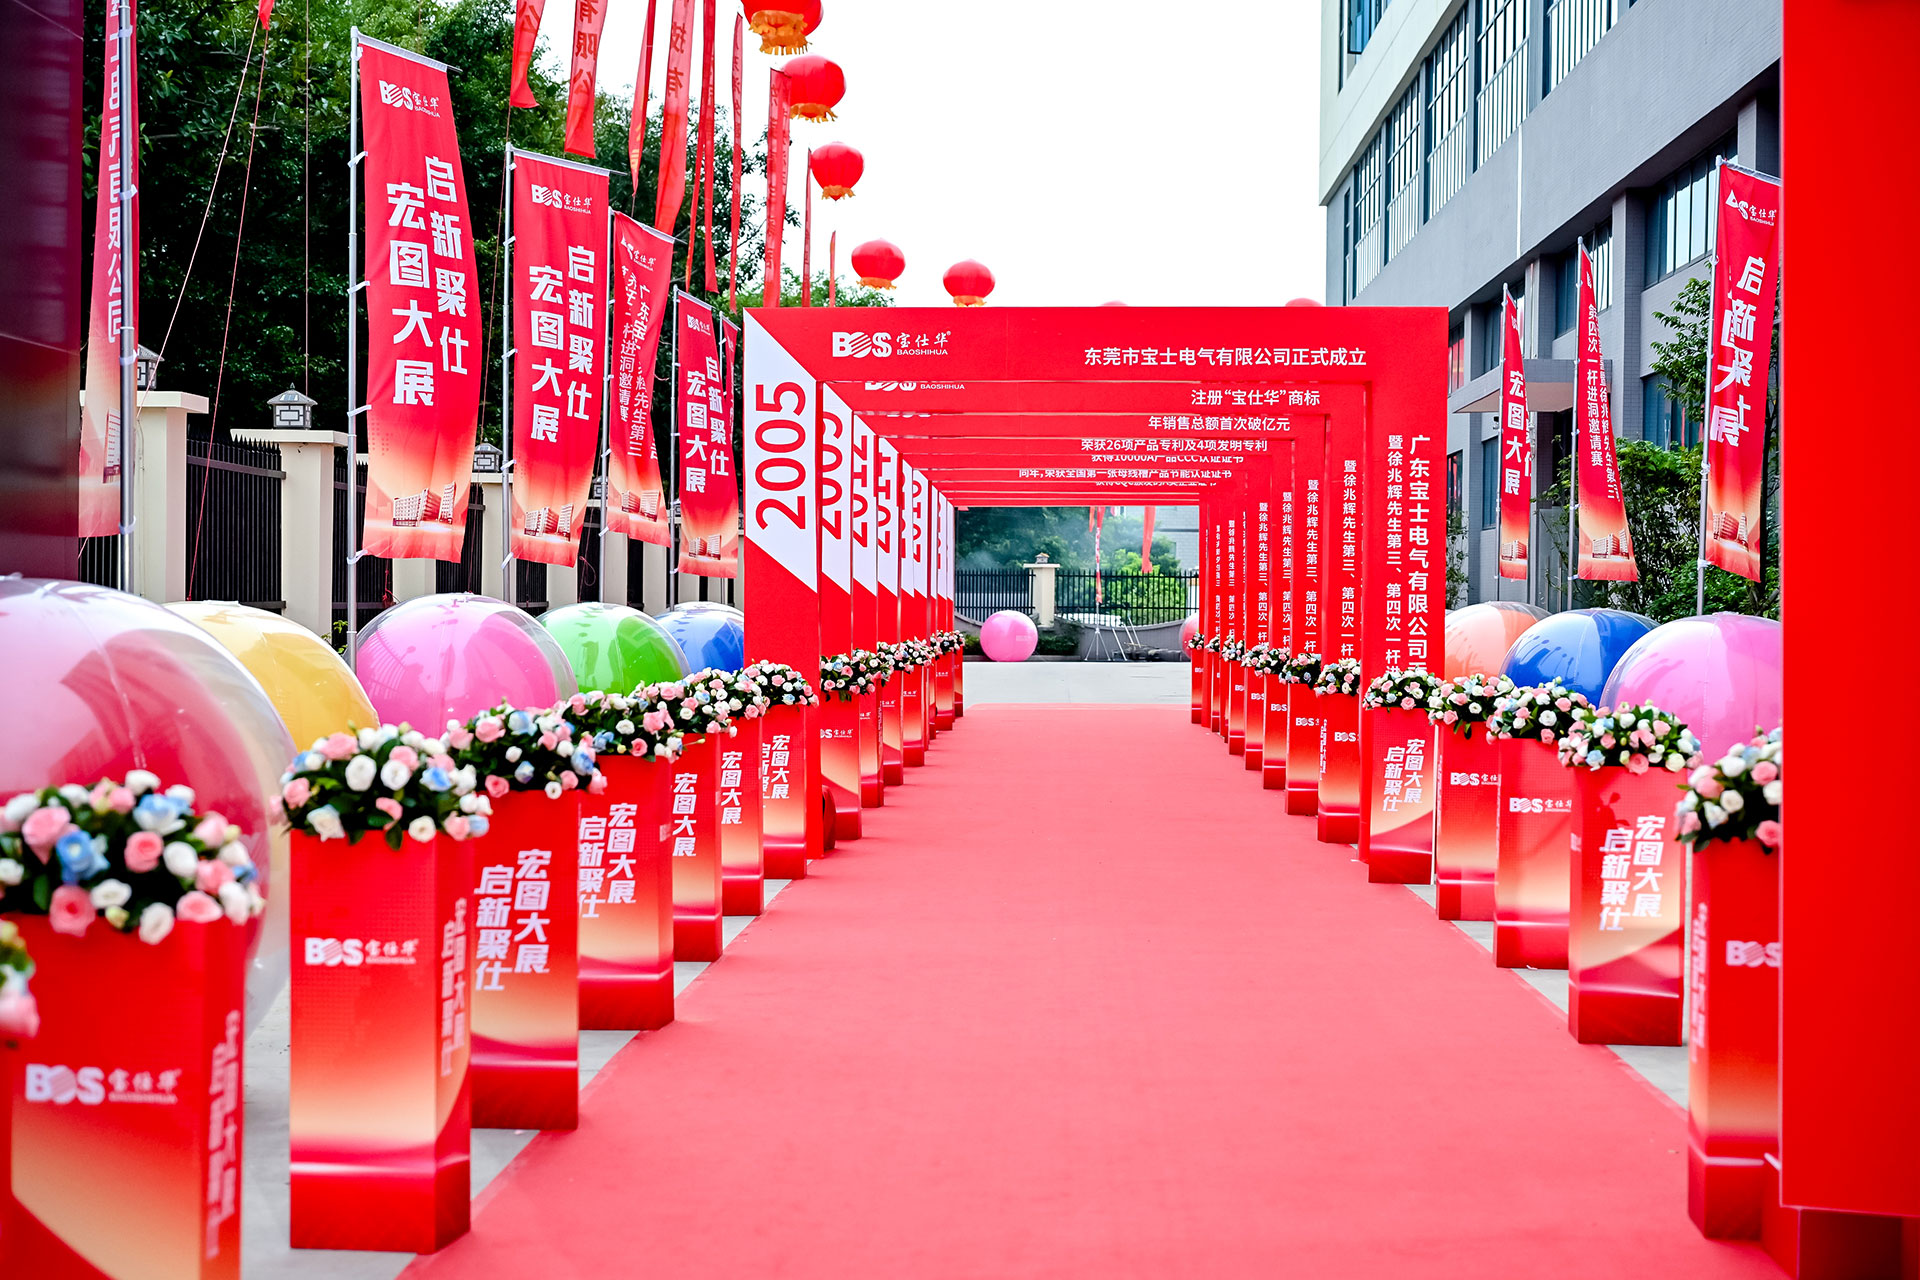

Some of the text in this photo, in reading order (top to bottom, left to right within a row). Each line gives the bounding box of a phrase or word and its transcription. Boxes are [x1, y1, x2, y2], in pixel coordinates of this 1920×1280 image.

[378, 79, 414, 111] BOS
[531, 183, 593, 210] BOS 宝仕华
[386, 181, 435, 407] 宏图大展
[425, 155, 469, 376] 启新聚仕
[528, 264, 564, 443] 宏图大展
[566, 245, 596, 421] 启新聚仕
[832, 331, 951, 359] BOS 宝仕华
[896, 348, 948, 356] BAOSHIHUA
[1084, 346, 1367, 367] 东莞市宝士电气有限公司正式成立
[685, 370, 708, 494] 宏图大展
[705, 355, 730, 477] 启新聚仕
[1081, 438, 1268, 452] 荣获26项产品专利及4项发明专利
[1148, 415, 1291, 432] 年销售总额首次破亿元
[1505, 370, 1525, 496] 宏图大展
[754, 381, 807, 530] 2005
[1257, 502, 1269, 645] 暨徐兆辉先生第三、第四次一杆
[1340, 459, 1358, 660] 暨徐兆辉先生第三、第四次一杆
[1270, 703, 1288, 712] BOS
[1295, 717, 1315, 727] BOS
[1334, 731, 1357, 742] BOS
[720, 750, 743, 825] 宏图大展
[770, 734, 791, 799] 宏图大展
[1382, 745, 1406, 813] 启新聚仕
[1403, 738, 1426, 804] 宏图大展
[1450, 772, 1480, 786] BOS
[672, 772, 698, 857] 宏图大展
[1509, 797, 1544, 813] BOS
[578, 815, 608, 918] 启新聚仕
[607, 802, 638, 904] 宏图大展
[1599, 828, 1635, 932] 启新聚仕
[1632, 814, 1667, 919] 宏图大展
[474, 863, 515, 991] 启新聚仕
[513, 848, 553, 975] 宏图大展
[304, 937, 364, 967] BOS
[1725, 940, 1783, 968] BOS
[25, 1062, 106, 1106] BOS
